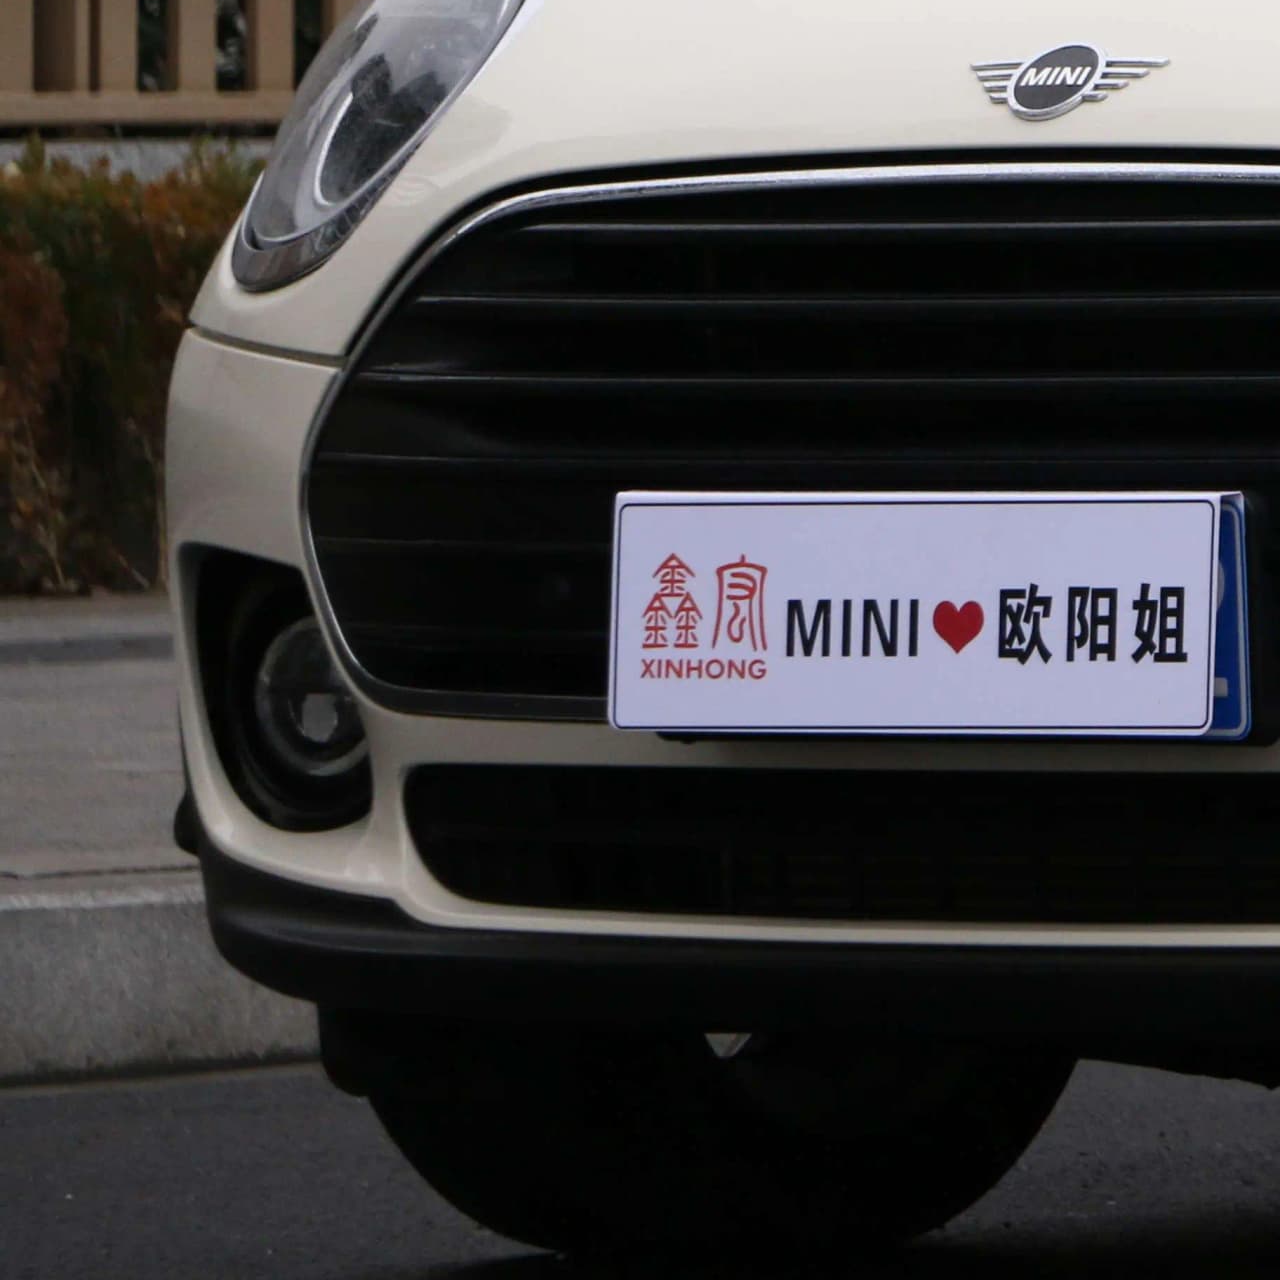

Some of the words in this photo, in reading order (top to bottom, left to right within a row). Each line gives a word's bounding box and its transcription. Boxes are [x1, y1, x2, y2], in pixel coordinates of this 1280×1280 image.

[1020, 67, 1091, 87] MINI
[785, 598, 919, 658] MINI
[1000, 582, 1188, 664] 欧阳姐
[640, 658, 768, 681] XINHONG
